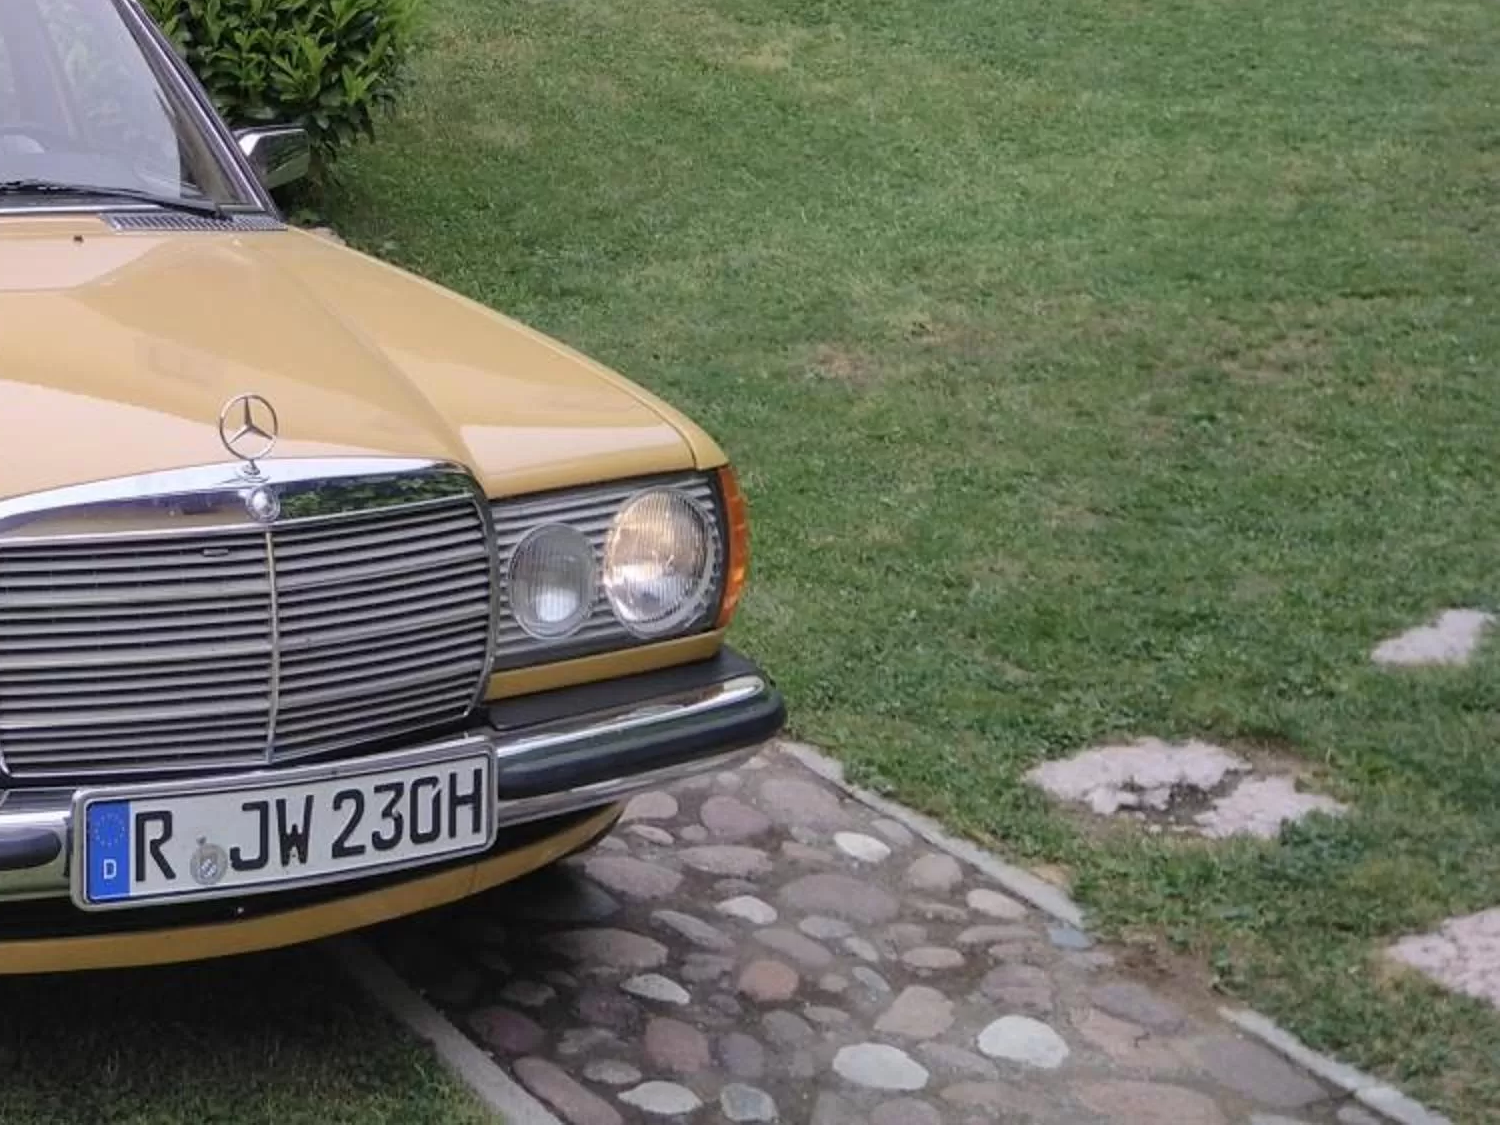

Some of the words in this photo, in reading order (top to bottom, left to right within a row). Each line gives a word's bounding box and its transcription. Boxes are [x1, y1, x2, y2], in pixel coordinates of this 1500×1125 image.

[135, 810, 176, 882] R
[230, 795, 314, 872] JW
[331, 768, 483, 859] 230H
[103, 858, 117, 880] D
